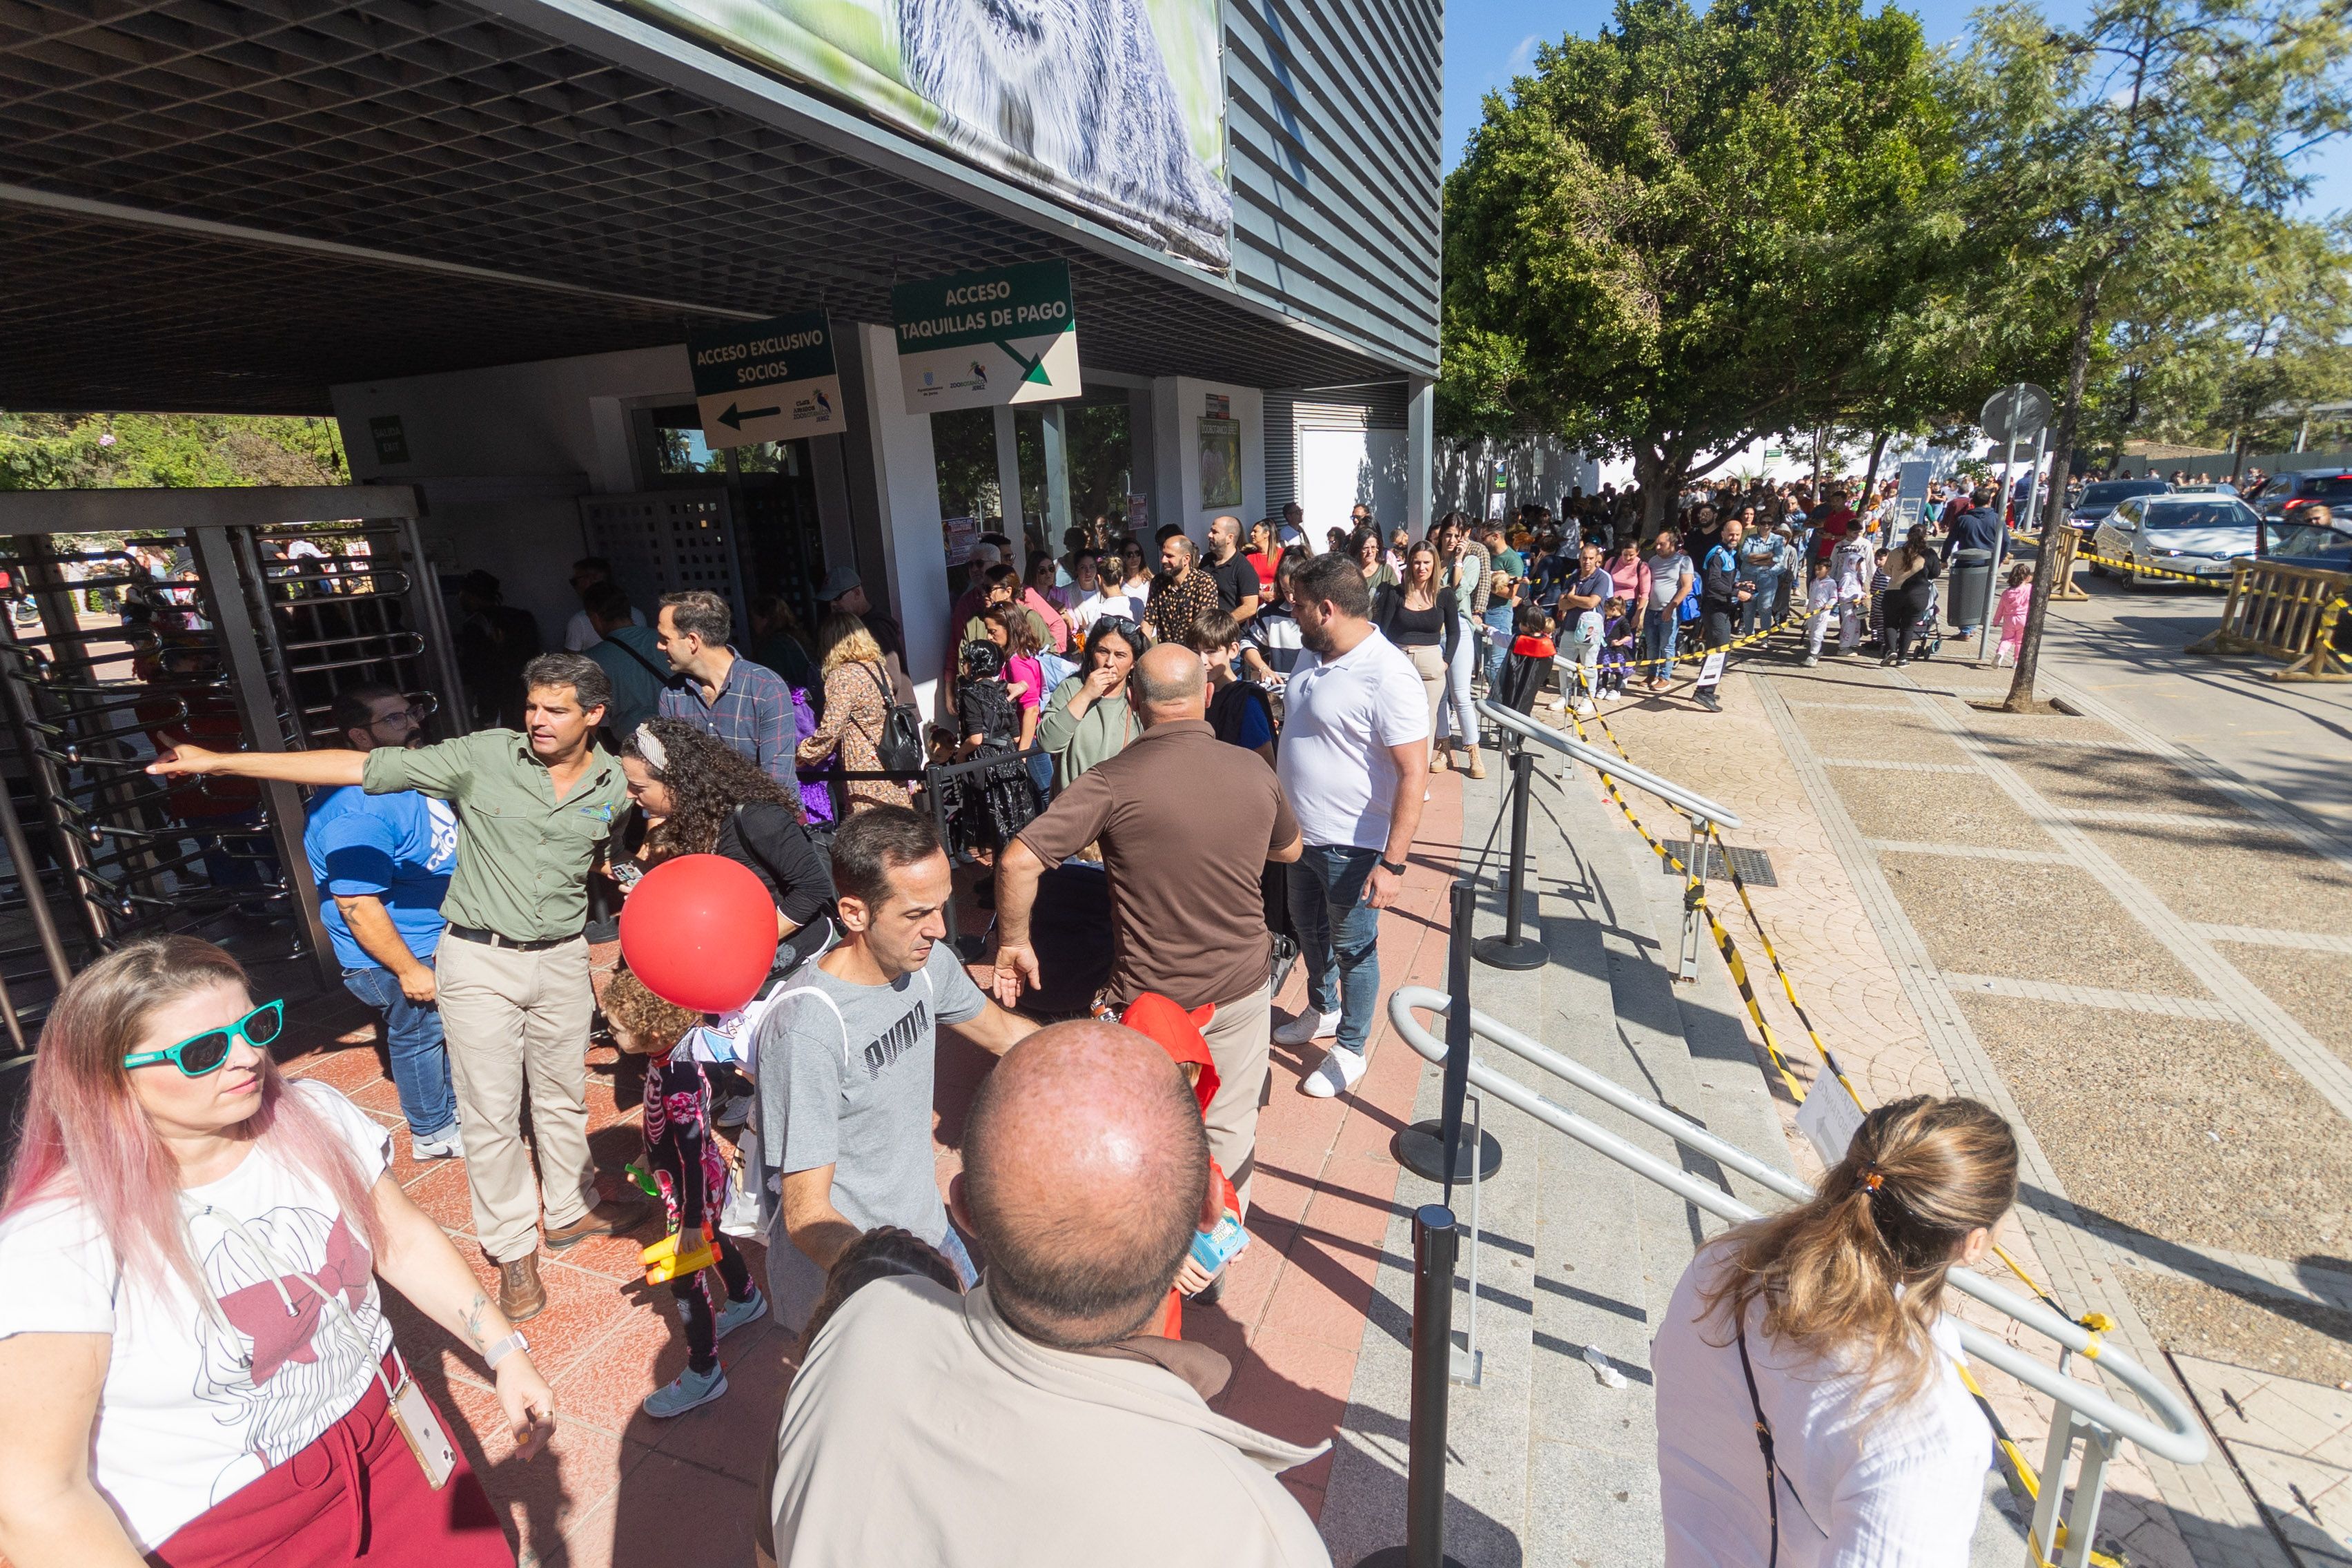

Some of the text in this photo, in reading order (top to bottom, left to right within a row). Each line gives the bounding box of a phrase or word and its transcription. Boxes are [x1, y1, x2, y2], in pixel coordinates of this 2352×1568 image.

[945, 281, 1010, 307] ACCESO
[899, 300, 1066, 340] TAQUILLAS DE PAGO
[697, 329, 823, 366] ACCESO EXCLUSIVO
[737, 361, 788, 383] SOCIOS
[374, 427, 402, 439] SALIDA
[383, 441, 400, 453] EXIT
[426, 825, 458, 871] adid
[864, 999, 929, 1082] PUMA
